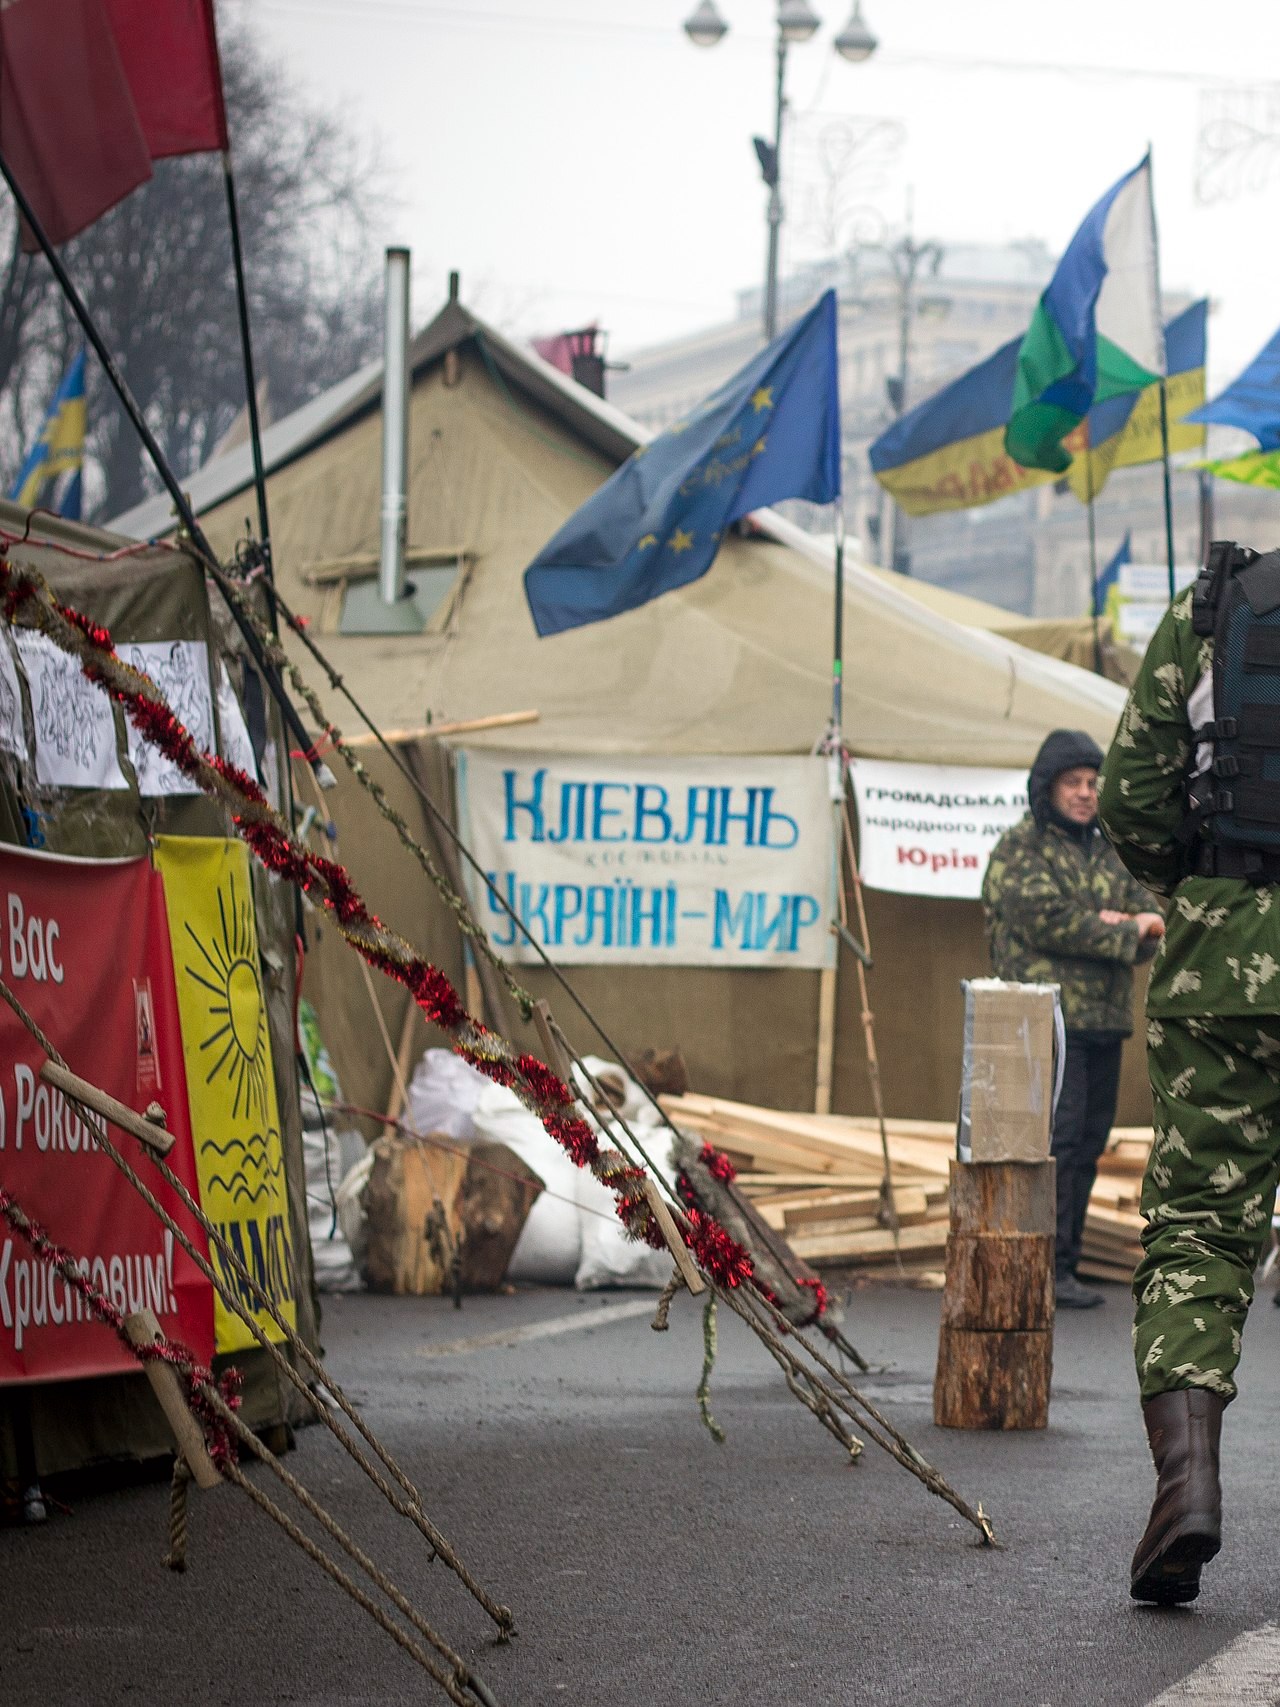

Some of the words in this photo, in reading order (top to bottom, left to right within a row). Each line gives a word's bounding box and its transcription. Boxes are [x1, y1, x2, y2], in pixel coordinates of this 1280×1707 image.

[502, 769, 799, 849] КЛЕВАНЬ
[866, 787, 1006, 809] ГРОМАДСЬКА
[866, 815, 977, 834] народного
[896, 846, 978, 873] Юрія
[8, 892, 64, 984] Вас
